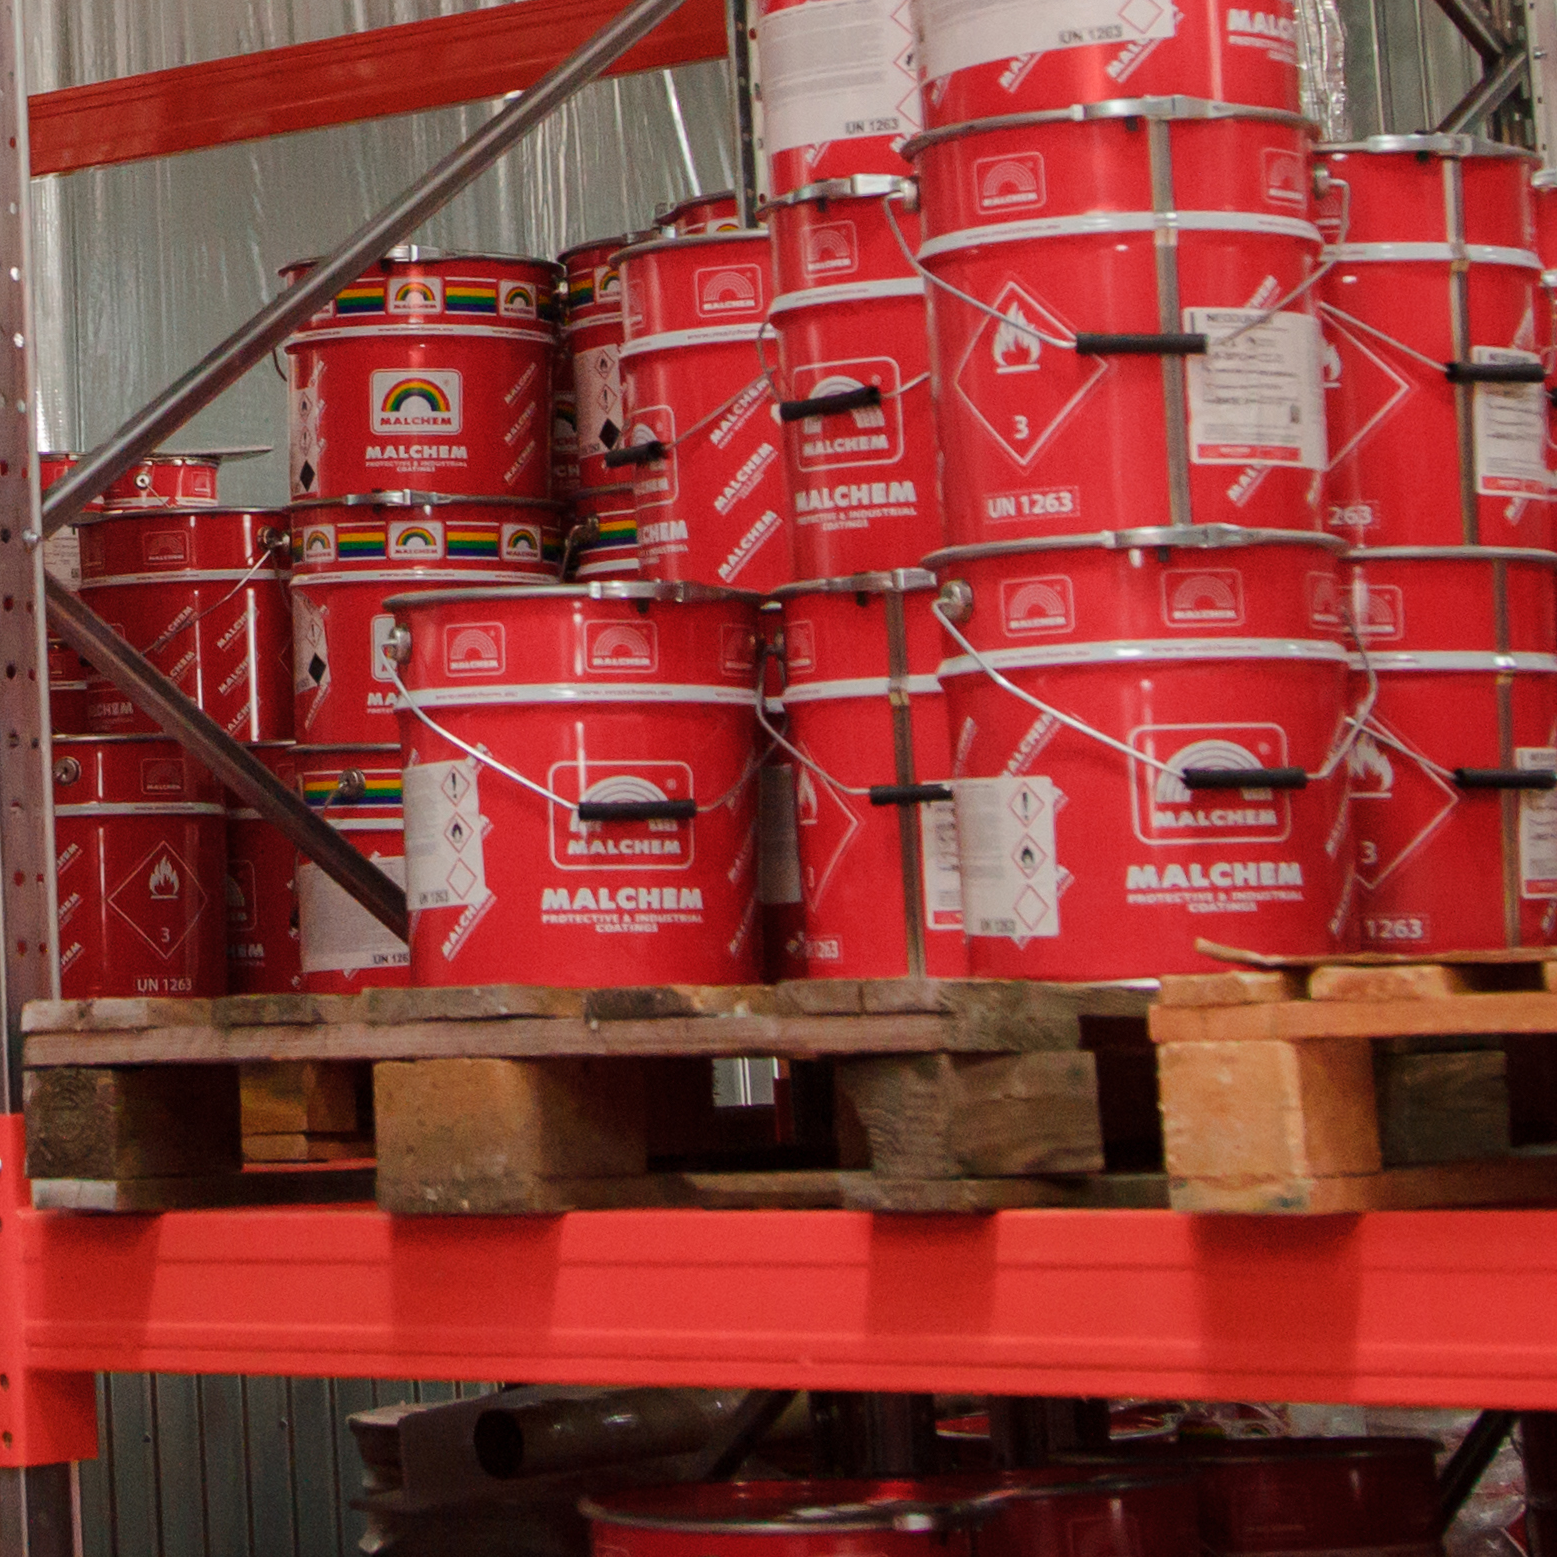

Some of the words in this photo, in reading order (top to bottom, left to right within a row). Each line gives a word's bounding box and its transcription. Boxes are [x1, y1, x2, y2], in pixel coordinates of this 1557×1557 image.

[868, 118, 899, 133] 1263
[380, 417, 452, 426] MALCHEM
[1014, 414, 1030, 439] 3
[365, 445, 468, 459] MALCHEM
[802, 434, 889, 457] MALCHEM
[714, 443, 774, 512] MALCHEM
[794, 480, 918, 513] MALCHEM
[988, 496, 1016, 517] UN
[1021, 492, 1074, 516] 1263
[718, 510, 777, 579] MALCHEM
[1153, 808, 1279, 829] MALCHEM
[567, 839, 682, 856] MALCHEM
[1361, 841, 1378, 865] 3
[1125, 861, 1305, 891] MALCHEM
[541, 887, 705, 912] MALCHEM
[542, 913, 620, 924] PROTECTIVE
[635, 913, 704, 924] INDUSTRIAL
[595, 923, 659, 933] COATINGS
[1365, 918, 1425, 940] 1263
[161, 927, 171, 944] 3
[373, 953, 389, 966] UN
[136, 979, 159, 992] UN
[163, 978, 192, 992] 1263
